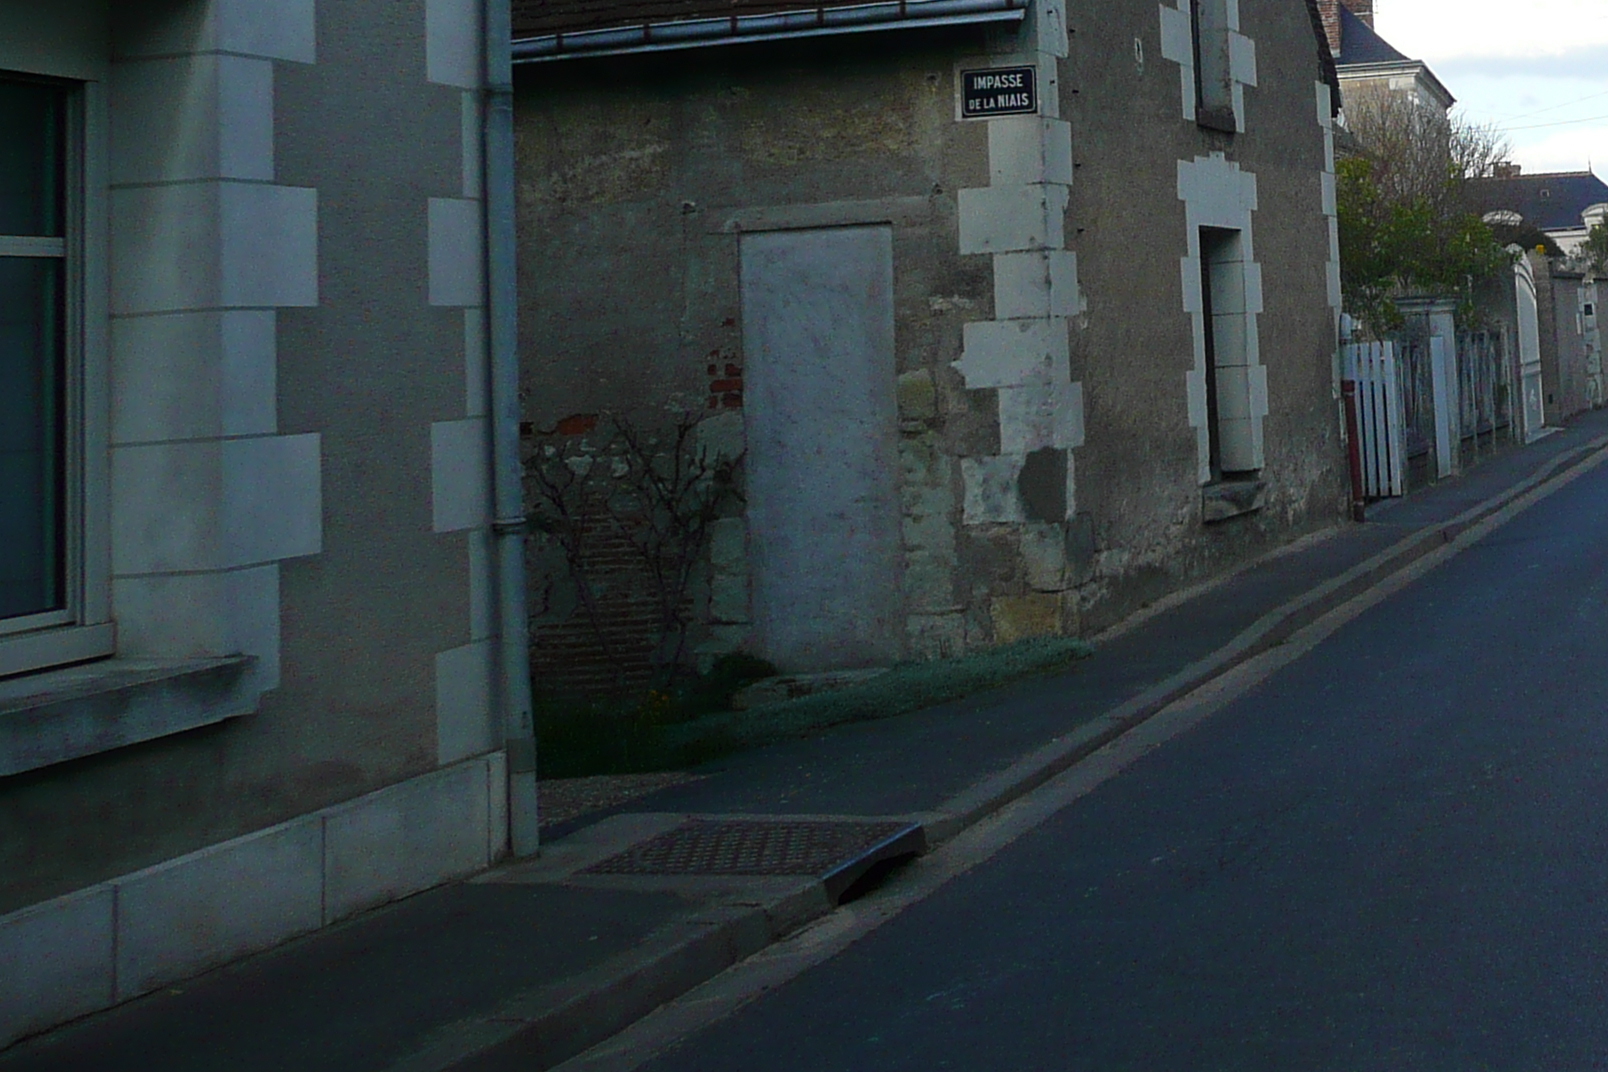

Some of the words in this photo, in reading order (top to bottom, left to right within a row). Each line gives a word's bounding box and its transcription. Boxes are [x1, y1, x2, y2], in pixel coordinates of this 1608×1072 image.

[973, 74, 1024, 90] IMPASSE
[968, 98, 982, 110] DE
[984, 97, 996, 109] LA
